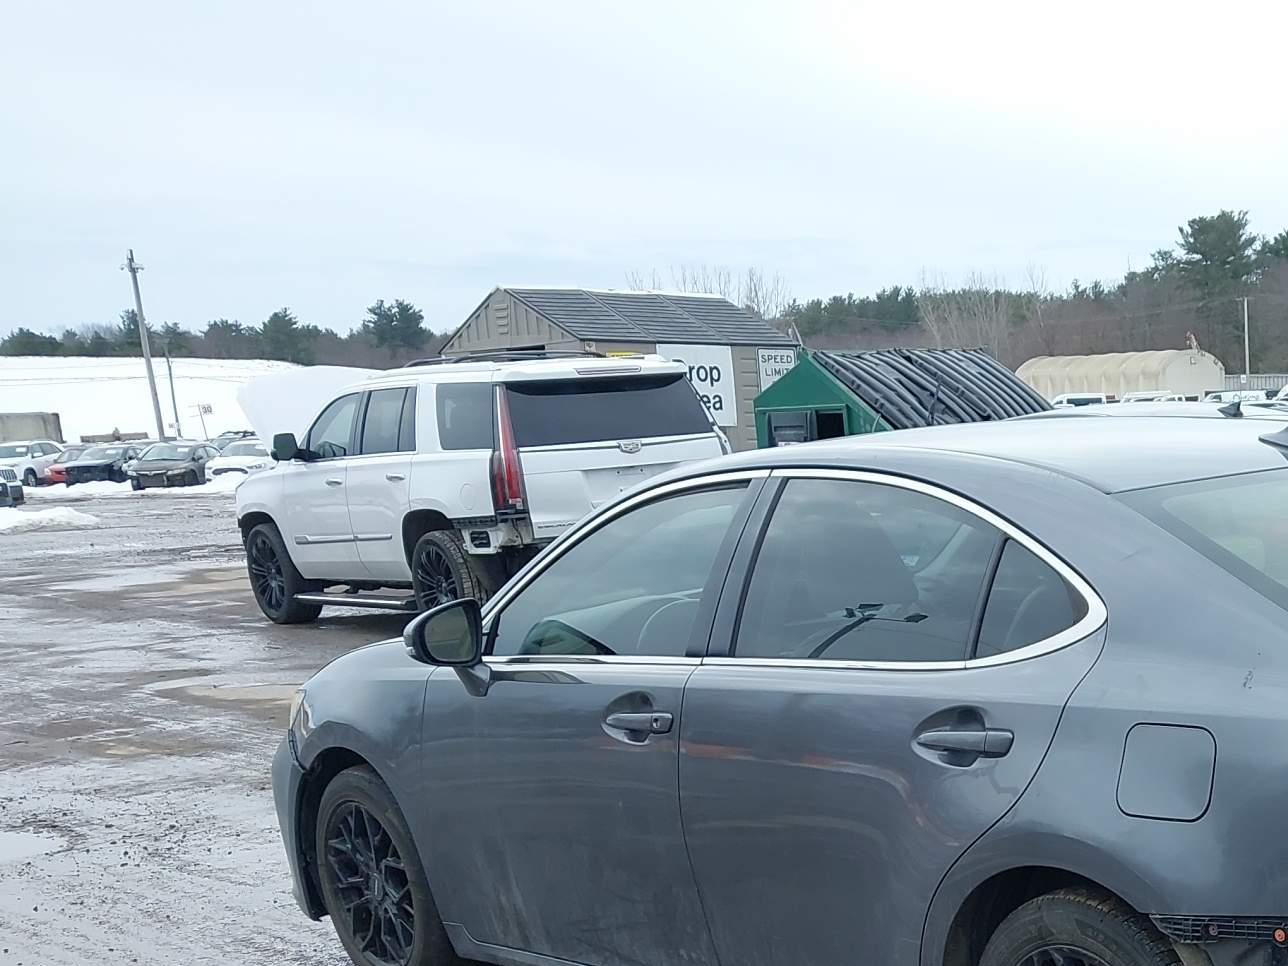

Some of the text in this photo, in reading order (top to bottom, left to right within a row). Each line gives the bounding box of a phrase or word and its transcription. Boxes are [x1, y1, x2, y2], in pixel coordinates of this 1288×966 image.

[760, 354, 793, 364] SPEED
[687, 364, 722, 387] rop
[700, 394, 723, 411] ea
